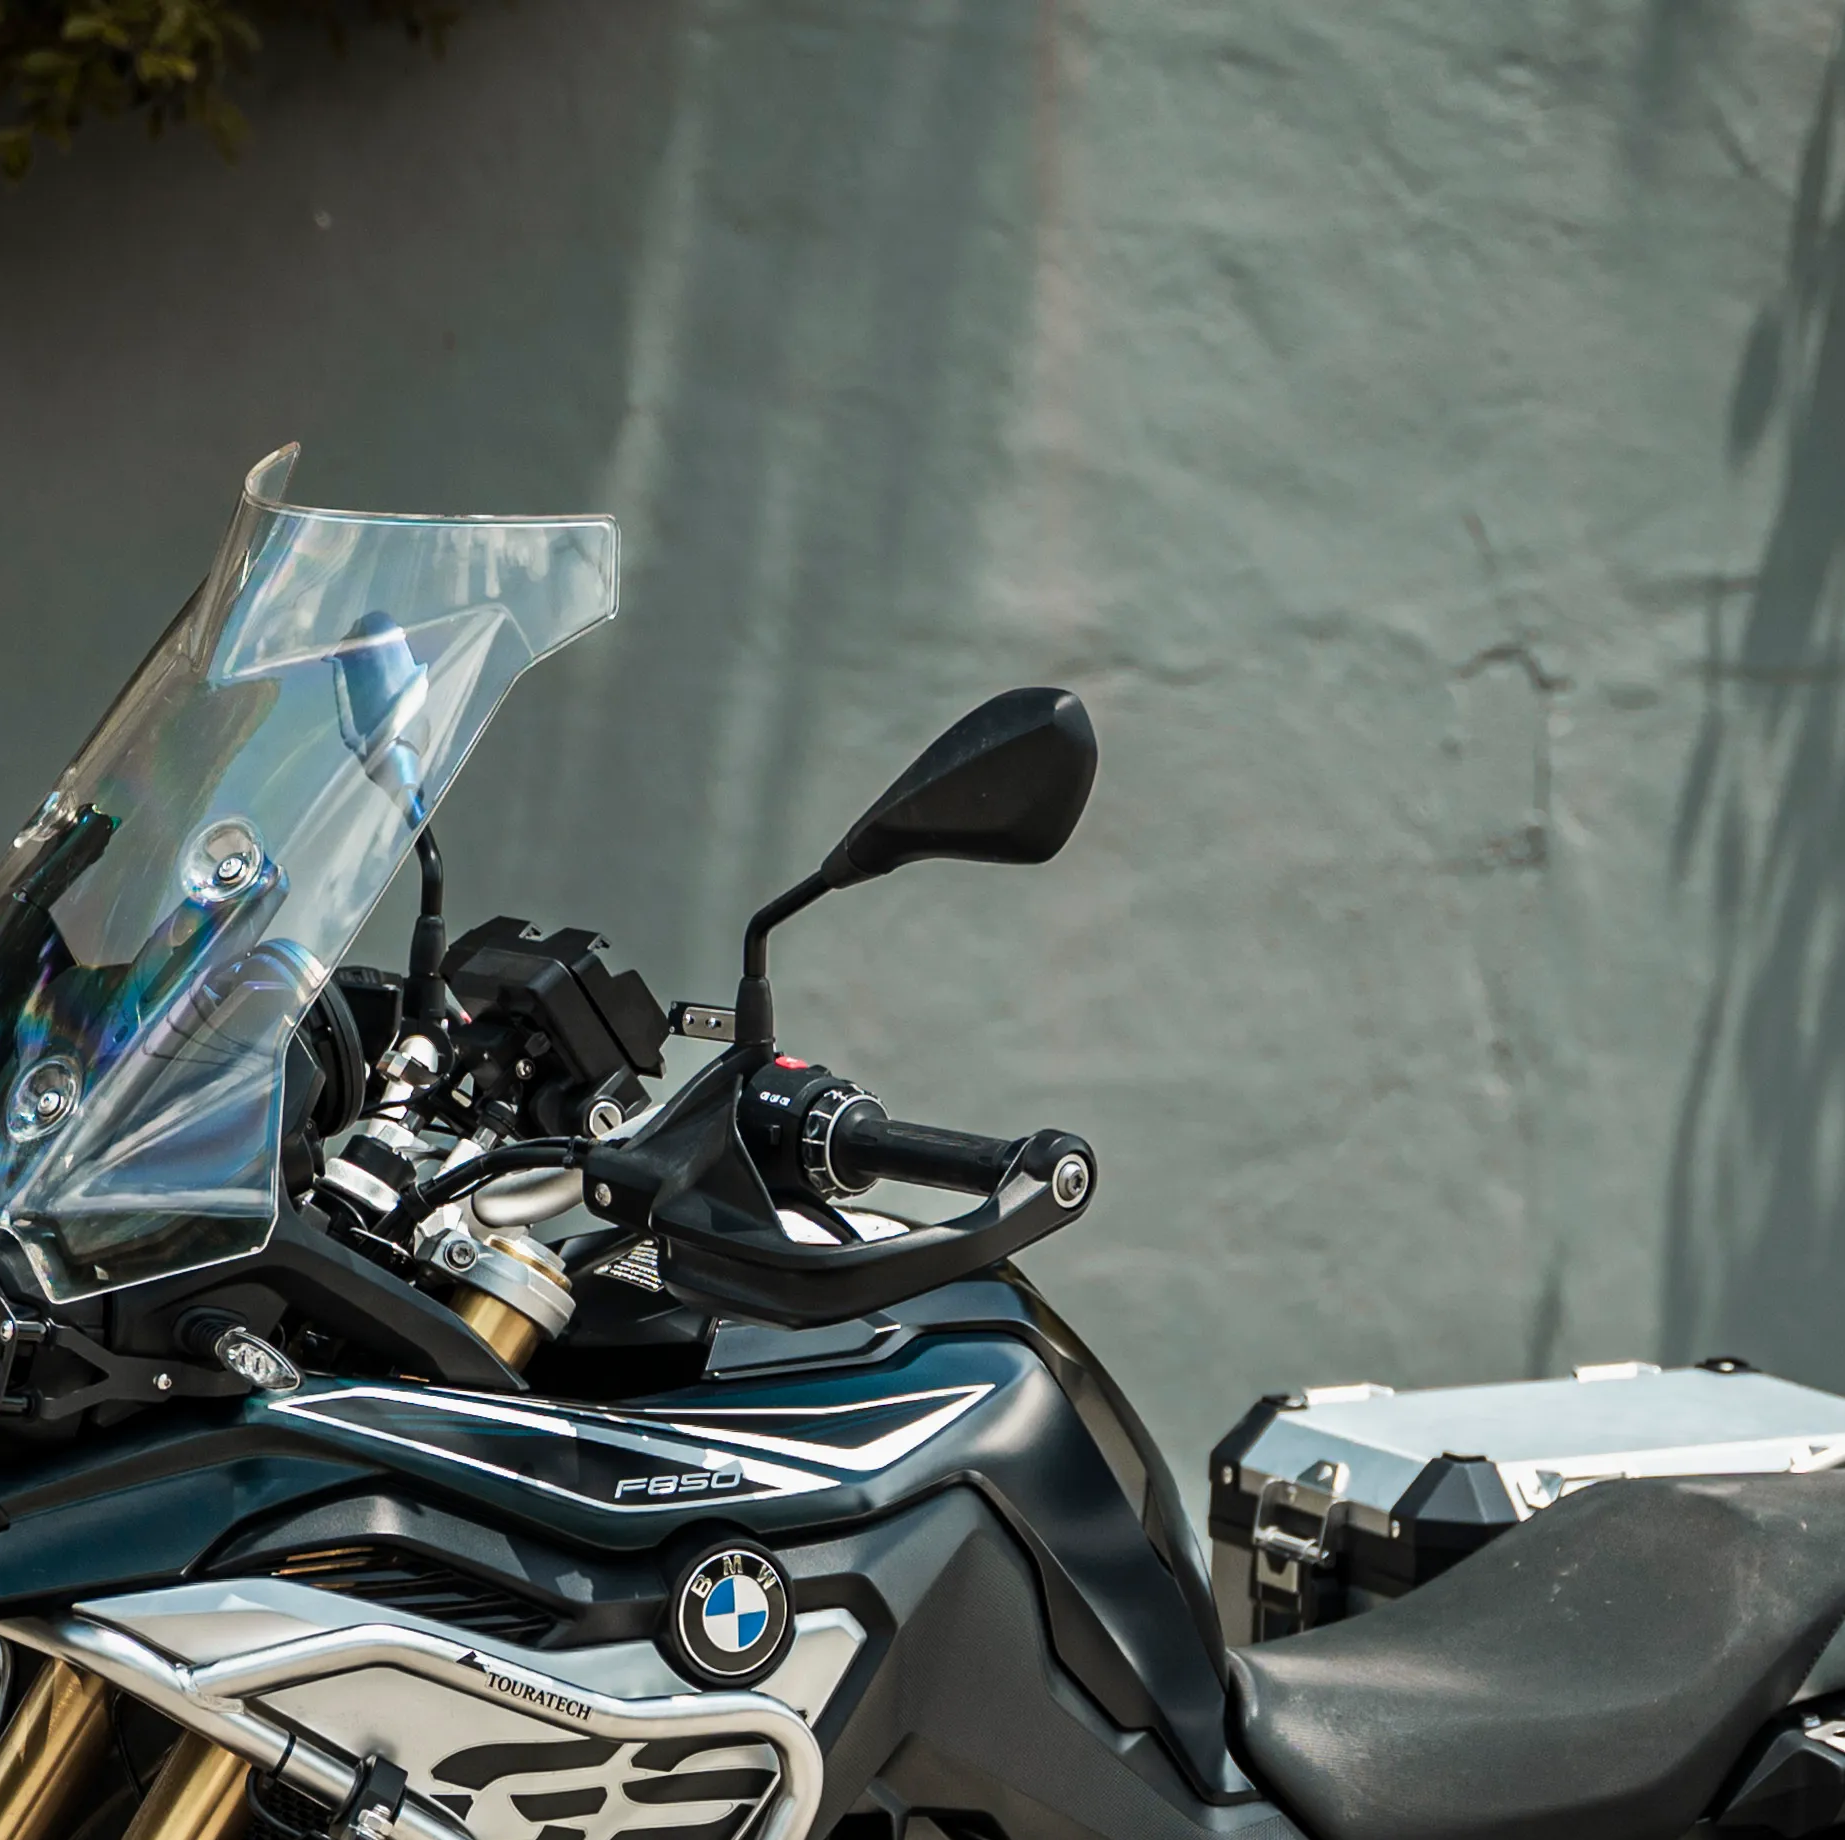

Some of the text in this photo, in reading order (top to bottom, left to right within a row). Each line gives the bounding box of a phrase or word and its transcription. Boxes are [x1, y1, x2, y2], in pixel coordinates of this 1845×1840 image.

[614, 1471, 744, 1499] F850
[691, 1555, 777, 1599] BMW
[488, 1671, 593, 1722] TOURATECH
